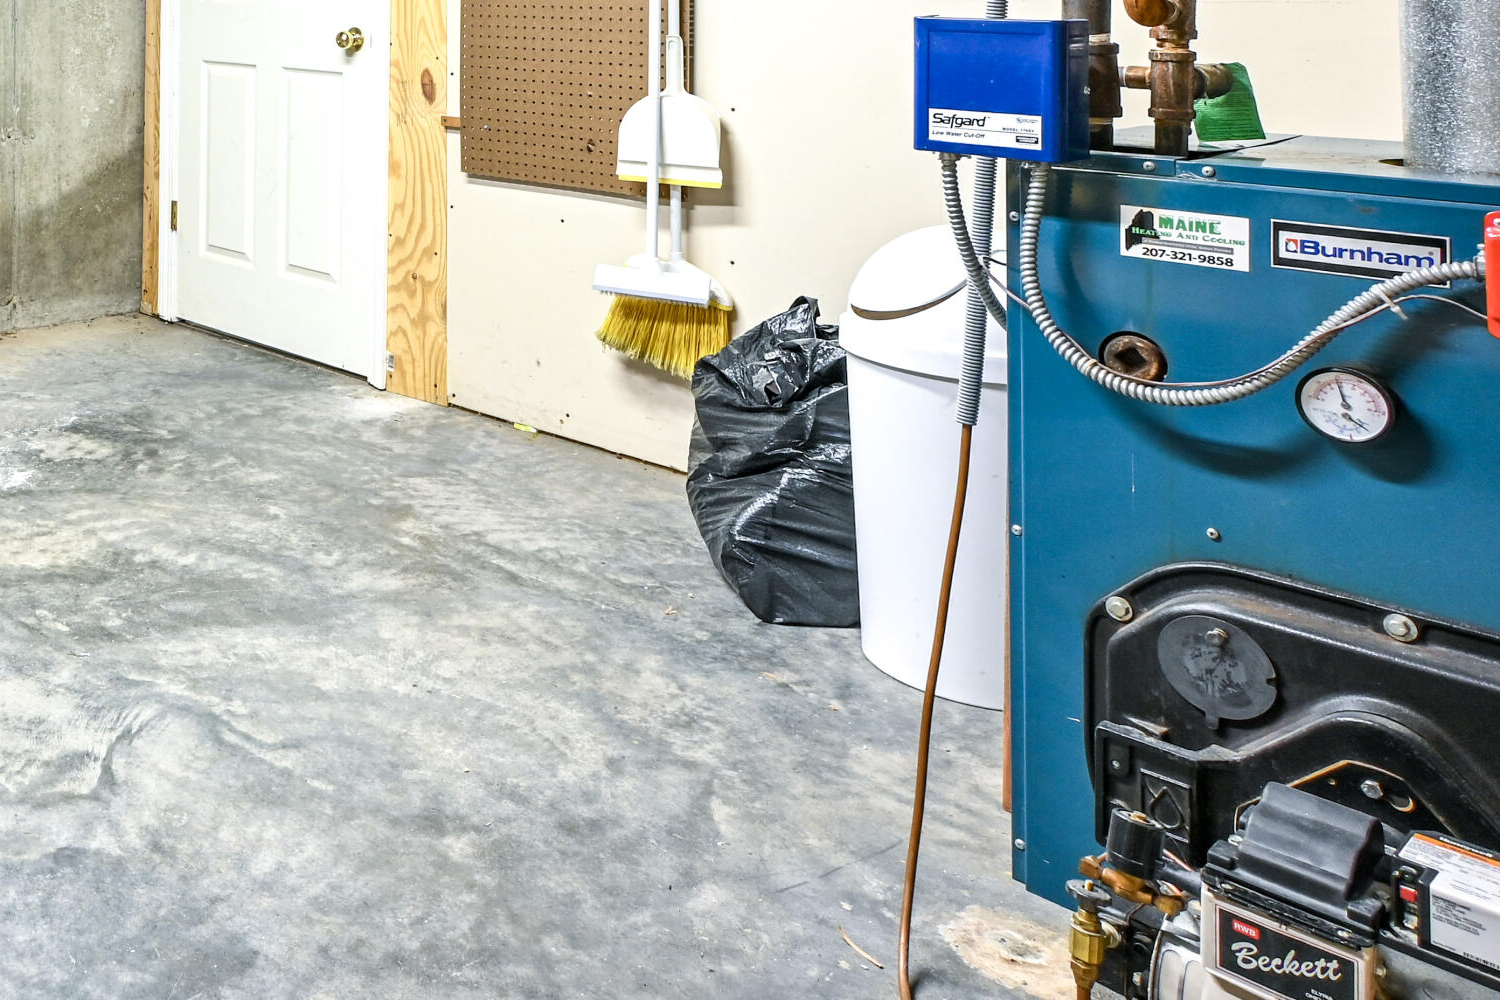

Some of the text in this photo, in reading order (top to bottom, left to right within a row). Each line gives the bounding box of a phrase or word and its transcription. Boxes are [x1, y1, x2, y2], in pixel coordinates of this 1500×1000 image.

[932, 113, 987, 129] Safgard
[1158, 214, 1221, 236] MAINE
[1141, 247, 1234, 267] 207-321-9858
[1299, 239, 1435, 268] Burnham
[1233, 921, 1257, 937] RWB
[1230, 941, 1342, 981] Beckett
